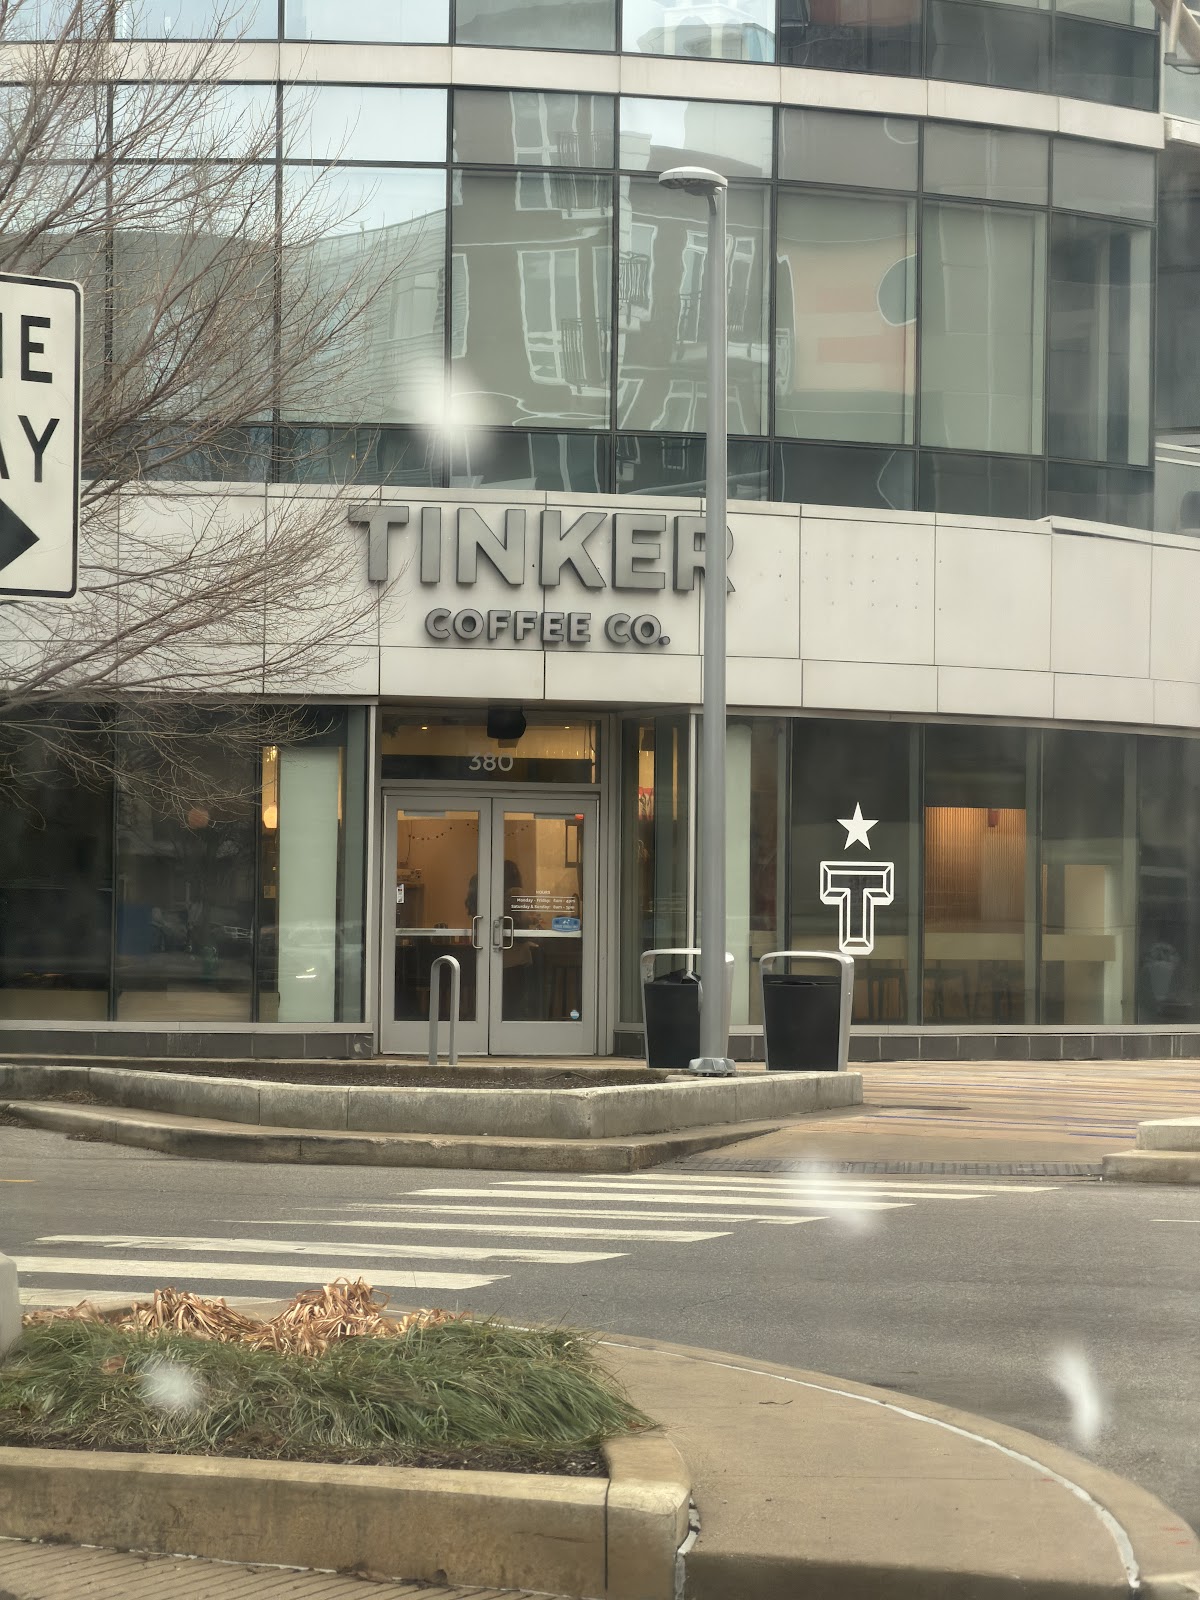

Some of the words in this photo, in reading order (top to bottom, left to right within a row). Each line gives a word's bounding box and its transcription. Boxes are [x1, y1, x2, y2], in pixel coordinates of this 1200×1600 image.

[0, 312, 53, 384] E
[348, 504, 736, 592] TINKER
[424, 607, 592, 643] COFFEE
[604, 612, 671, 646] CO.
[468, 752, 514, 772] 380
